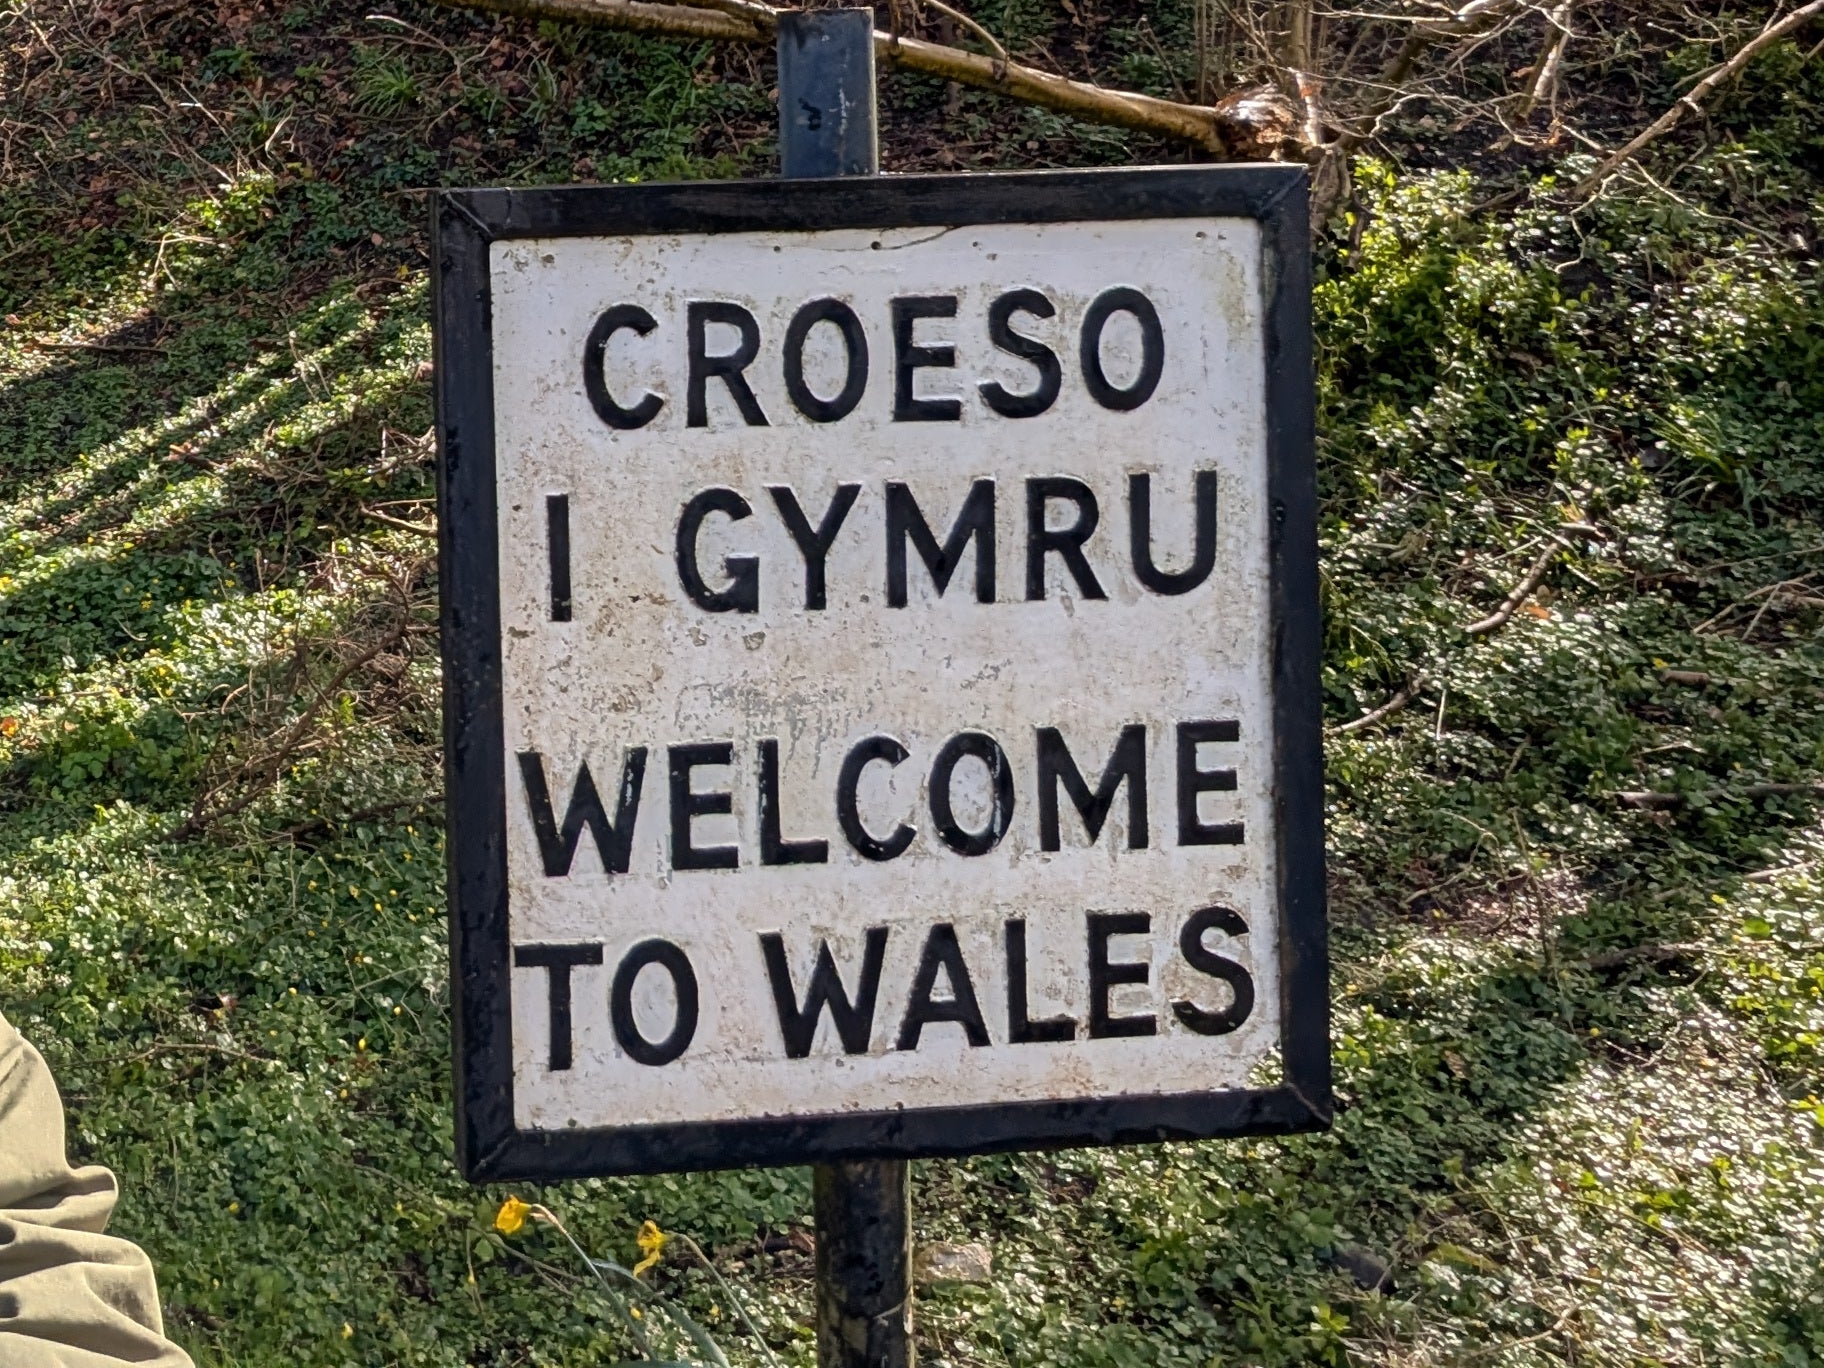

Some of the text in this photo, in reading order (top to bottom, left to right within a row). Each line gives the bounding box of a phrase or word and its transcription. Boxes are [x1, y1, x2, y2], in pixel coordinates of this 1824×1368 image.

[582, 287, 1165, 431] CROESO
[546, 469, 1218, 623] I GYMRU
[516, 719, 1245, 878] WELCOME
[512, 905, 1255, 1073] TO WALES
